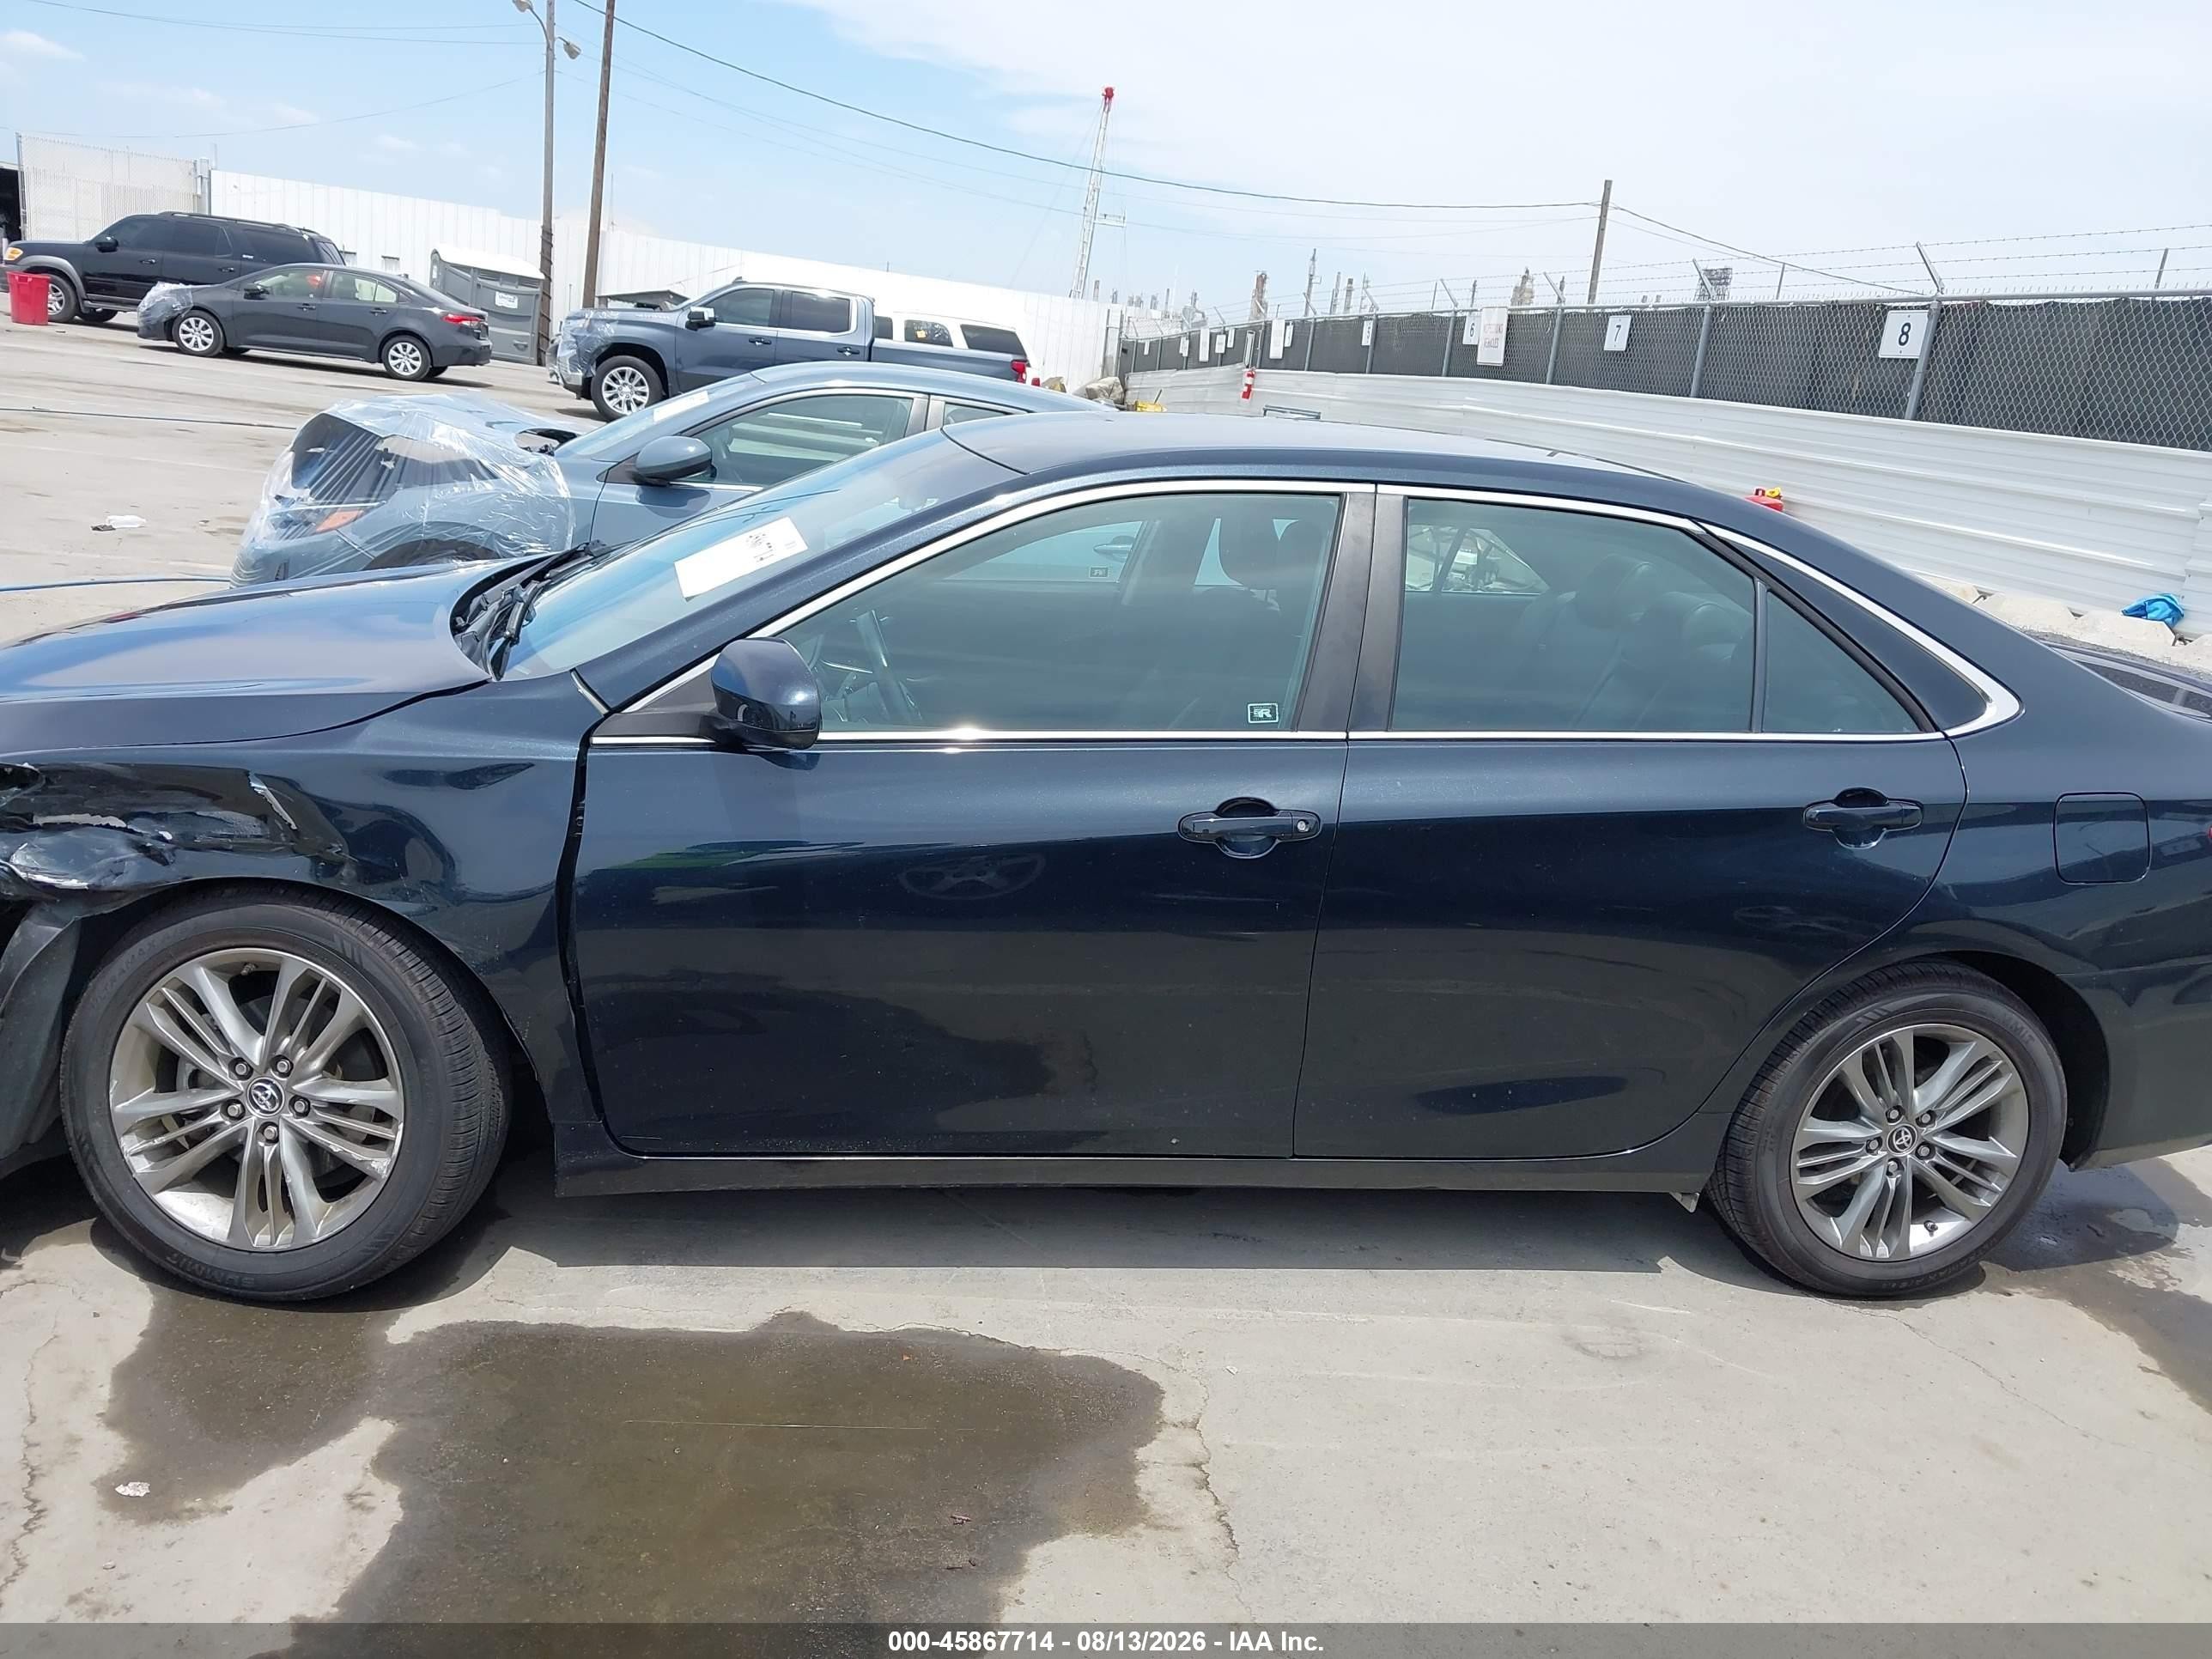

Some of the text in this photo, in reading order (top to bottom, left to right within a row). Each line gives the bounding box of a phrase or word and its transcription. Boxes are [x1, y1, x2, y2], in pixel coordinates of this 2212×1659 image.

[1469, 323, 1475, 337] 6
[1614, 325, 1621, 342] 7
[1899, 322, 1911, 346] 8
